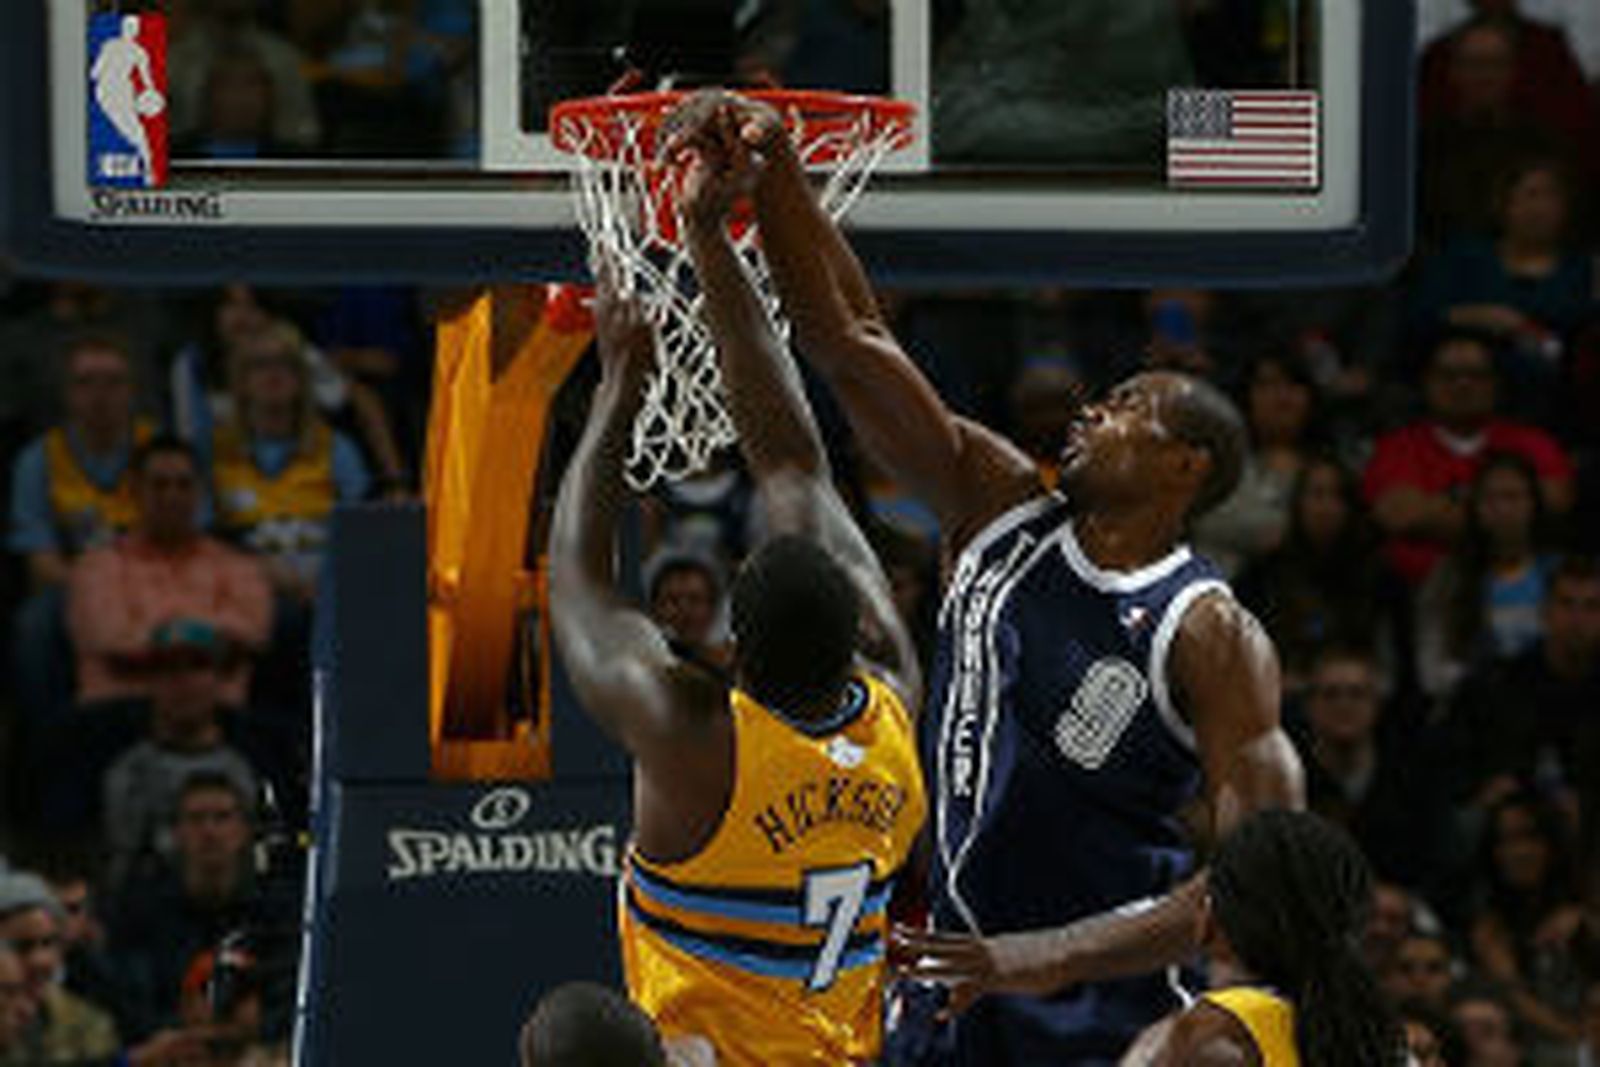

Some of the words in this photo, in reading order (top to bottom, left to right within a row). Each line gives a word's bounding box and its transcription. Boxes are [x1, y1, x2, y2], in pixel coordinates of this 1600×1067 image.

[387, 824, 616, 878] SPALDING
[755, 777, 909, 853] HICKSO
[804, 861, 872, 988] 7
